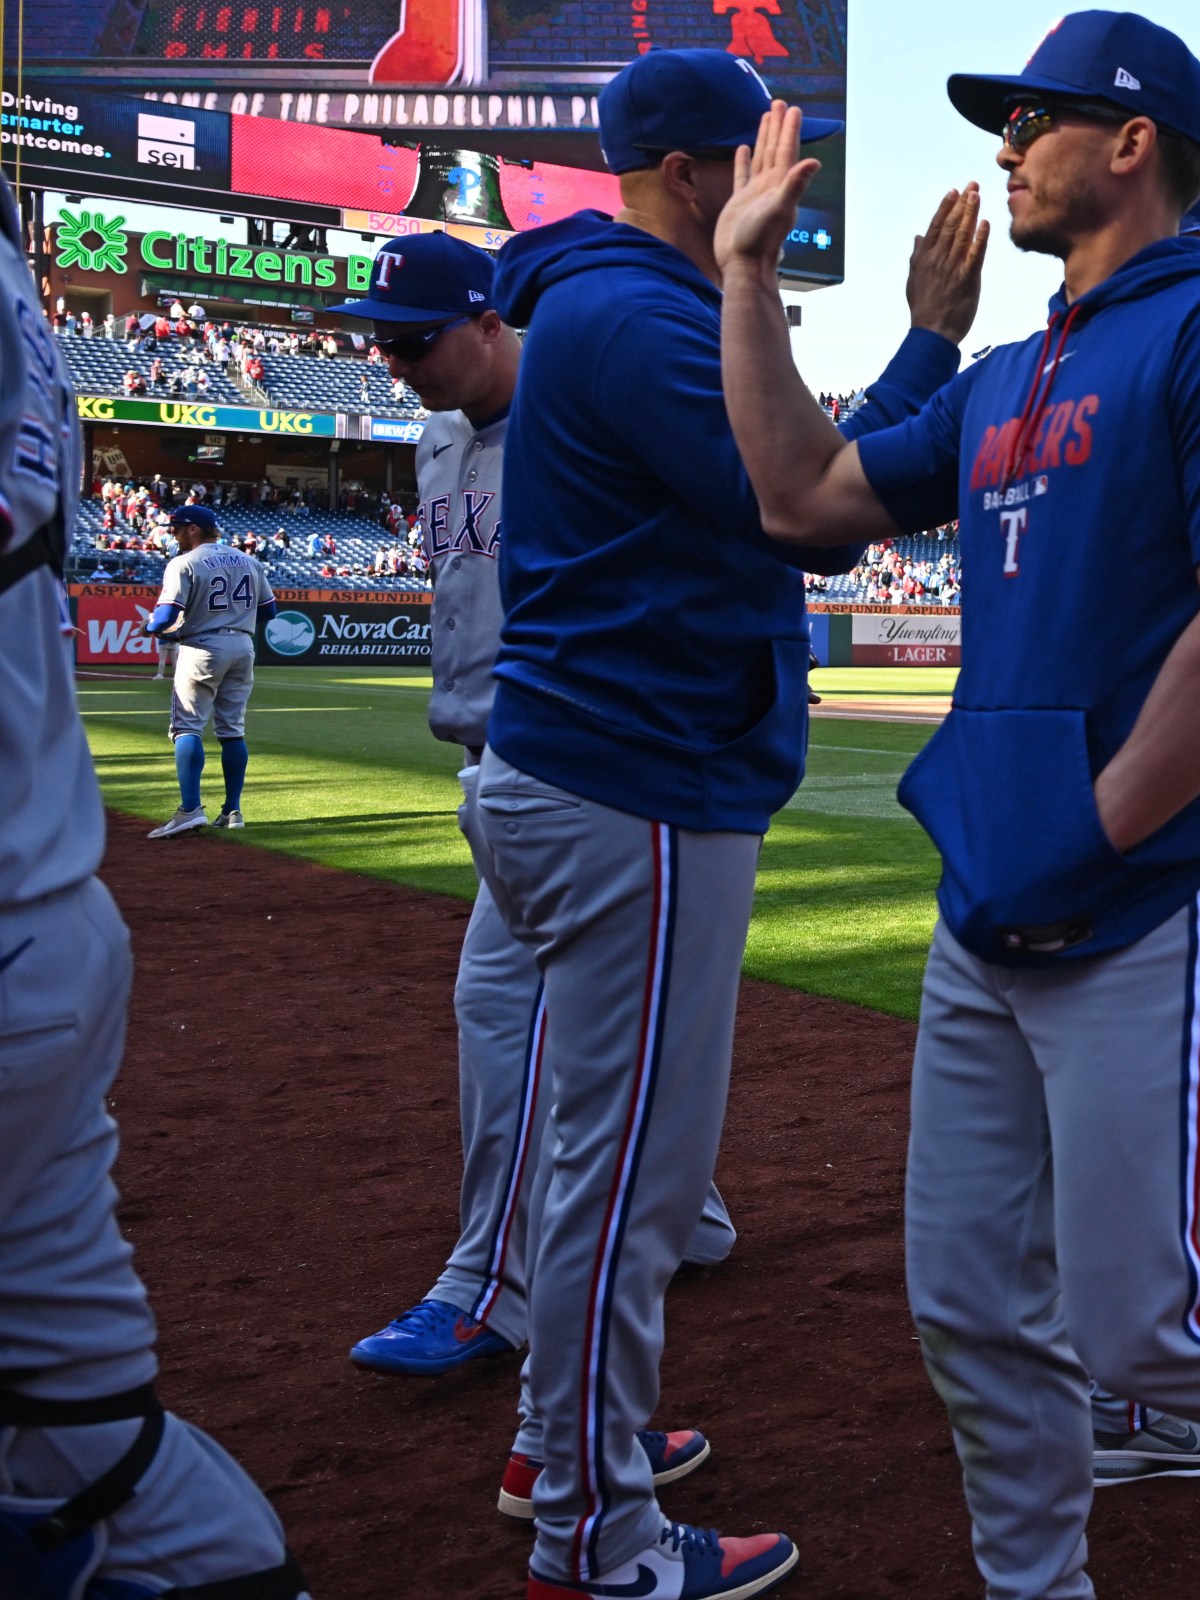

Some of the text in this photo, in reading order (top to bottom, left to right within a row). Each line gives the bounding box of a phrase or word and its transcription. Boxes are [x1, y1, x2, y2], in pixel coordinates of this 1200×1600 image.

[0, 91, 79, 121] Driving
[280, 93, 330, 123] THE
[344, 93, 557, 128] PHILADELPHIA
[0, 113, 84, 136] smarter
[0, 132, 112, 158] outcomes.
[141, 230, 337, 288] Citizens
[376, 251, 404, 290] T
[77, 396, 314, 435] KG UKG UKG
[1000, 507, 1028, 579] T
[203, 554, 250, 571] NIMMO
[80, 585, 161, 598] ASPLUN
[208, 573, 254, 612] 24
[329, 591, 424, 604] ASPLUNDH
[823, 603, 961, 616] ASPLUNDH ASPLUND
[87, 619, 160, 655] Wa
[318, 614, 432, 640] NovaCar
[877, 617, 960, 644] Yuengling
[318, 643, 433, 656] REHABILITATIO
[892, 647, 947, 662] LAGER
